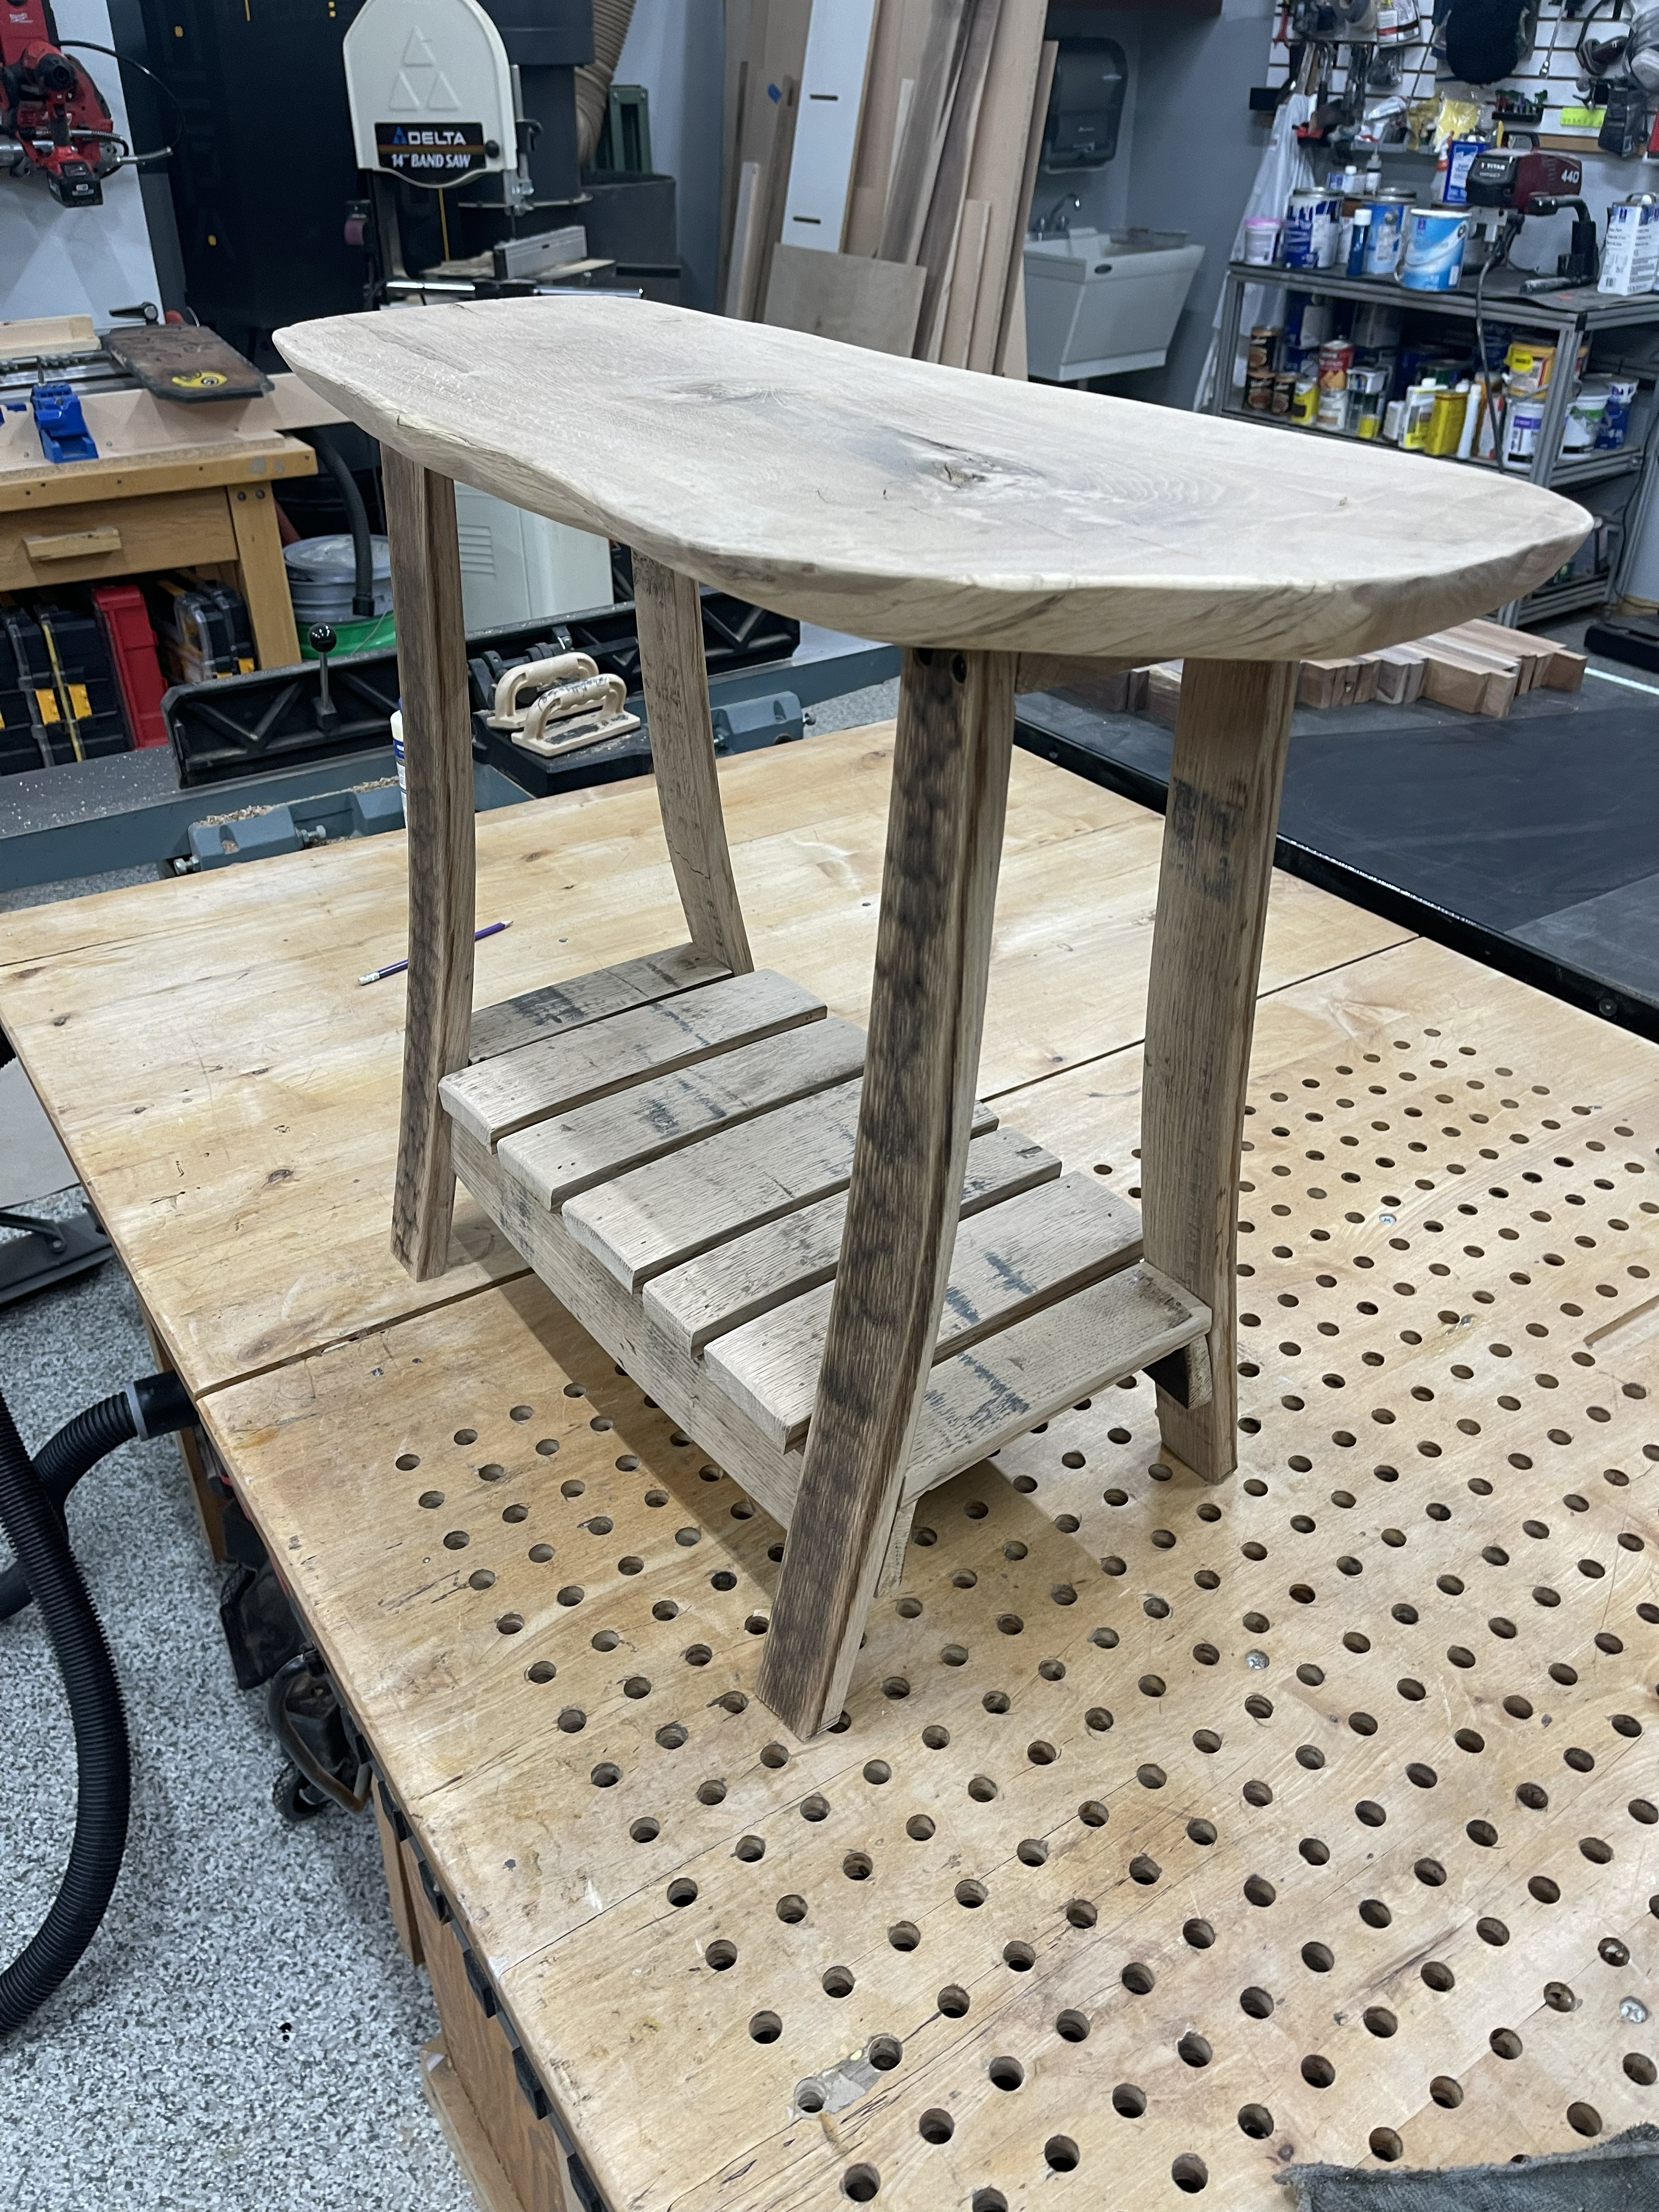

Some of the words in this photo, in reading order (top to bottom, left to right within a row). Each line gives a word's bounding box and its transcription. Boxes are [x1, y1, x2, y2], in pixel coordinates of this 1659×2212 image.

[408, 131, 467, 145] DELTA
[411, 154, 444, 168] BAND
[445, 154, 471, 168] SAW
[1561, 169, 1580, 184] 440
